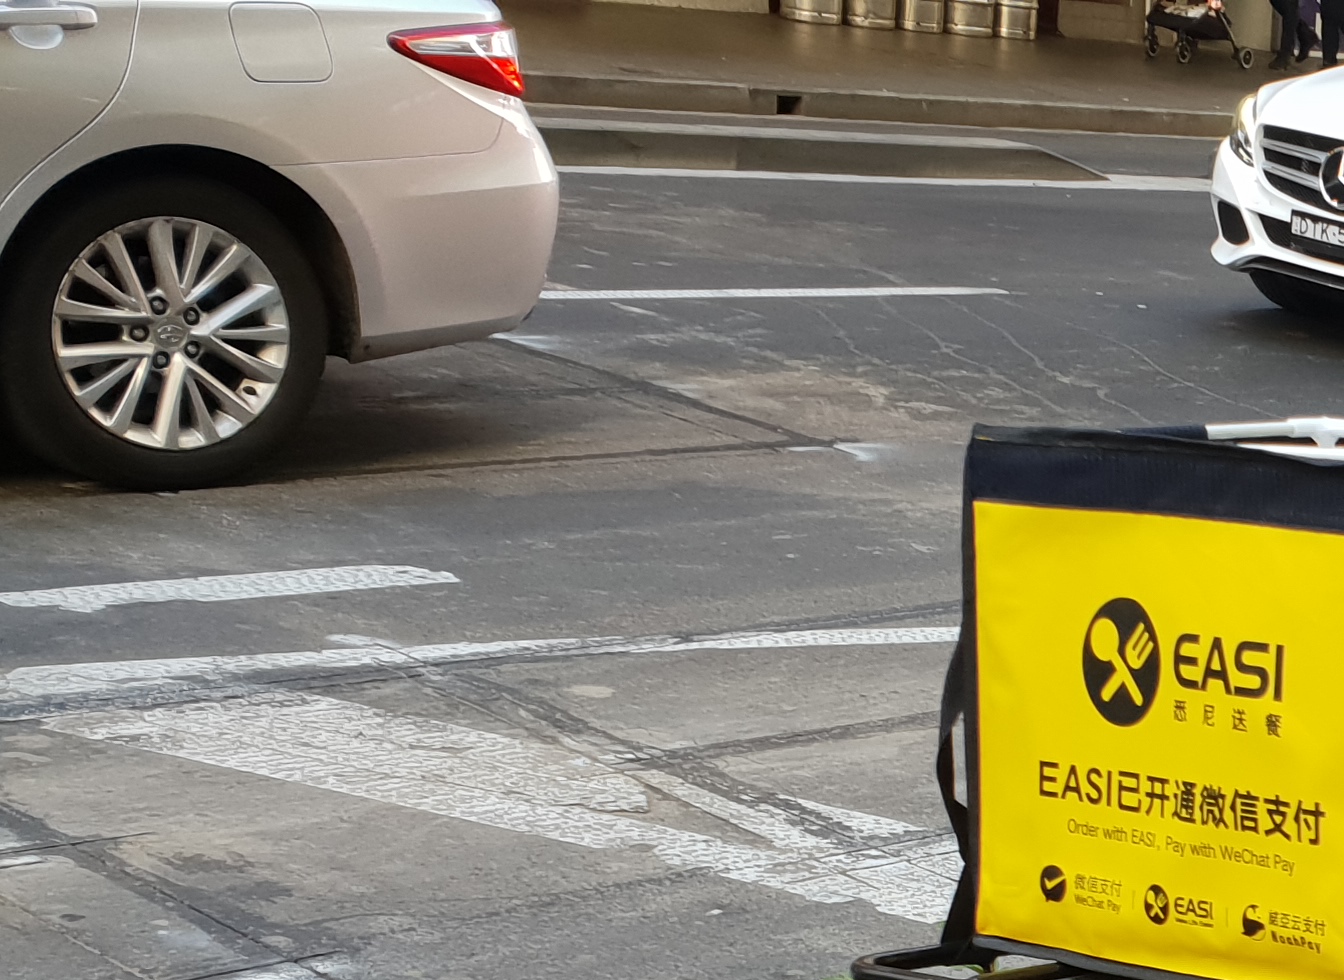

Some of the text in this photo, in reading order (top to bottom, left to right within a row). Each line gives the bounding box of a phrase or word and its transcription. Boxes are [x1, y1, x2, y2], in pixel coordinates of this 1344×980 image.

[1173, 632, 1285, 703] EASI
[1067, 818, 1099, 838] Order
[1102, 825, 1128, 843] with
[1165, 835, 1187, 858] Pay
[1189, 842, 1217, 859] with
[1219, 844, 1271, 869] WeChat
[1273, 853, 1296, 877] Pay
[1074, 893, 1122, 915] WeChat Pay
[1174, 896, 1214, 920] EASI
